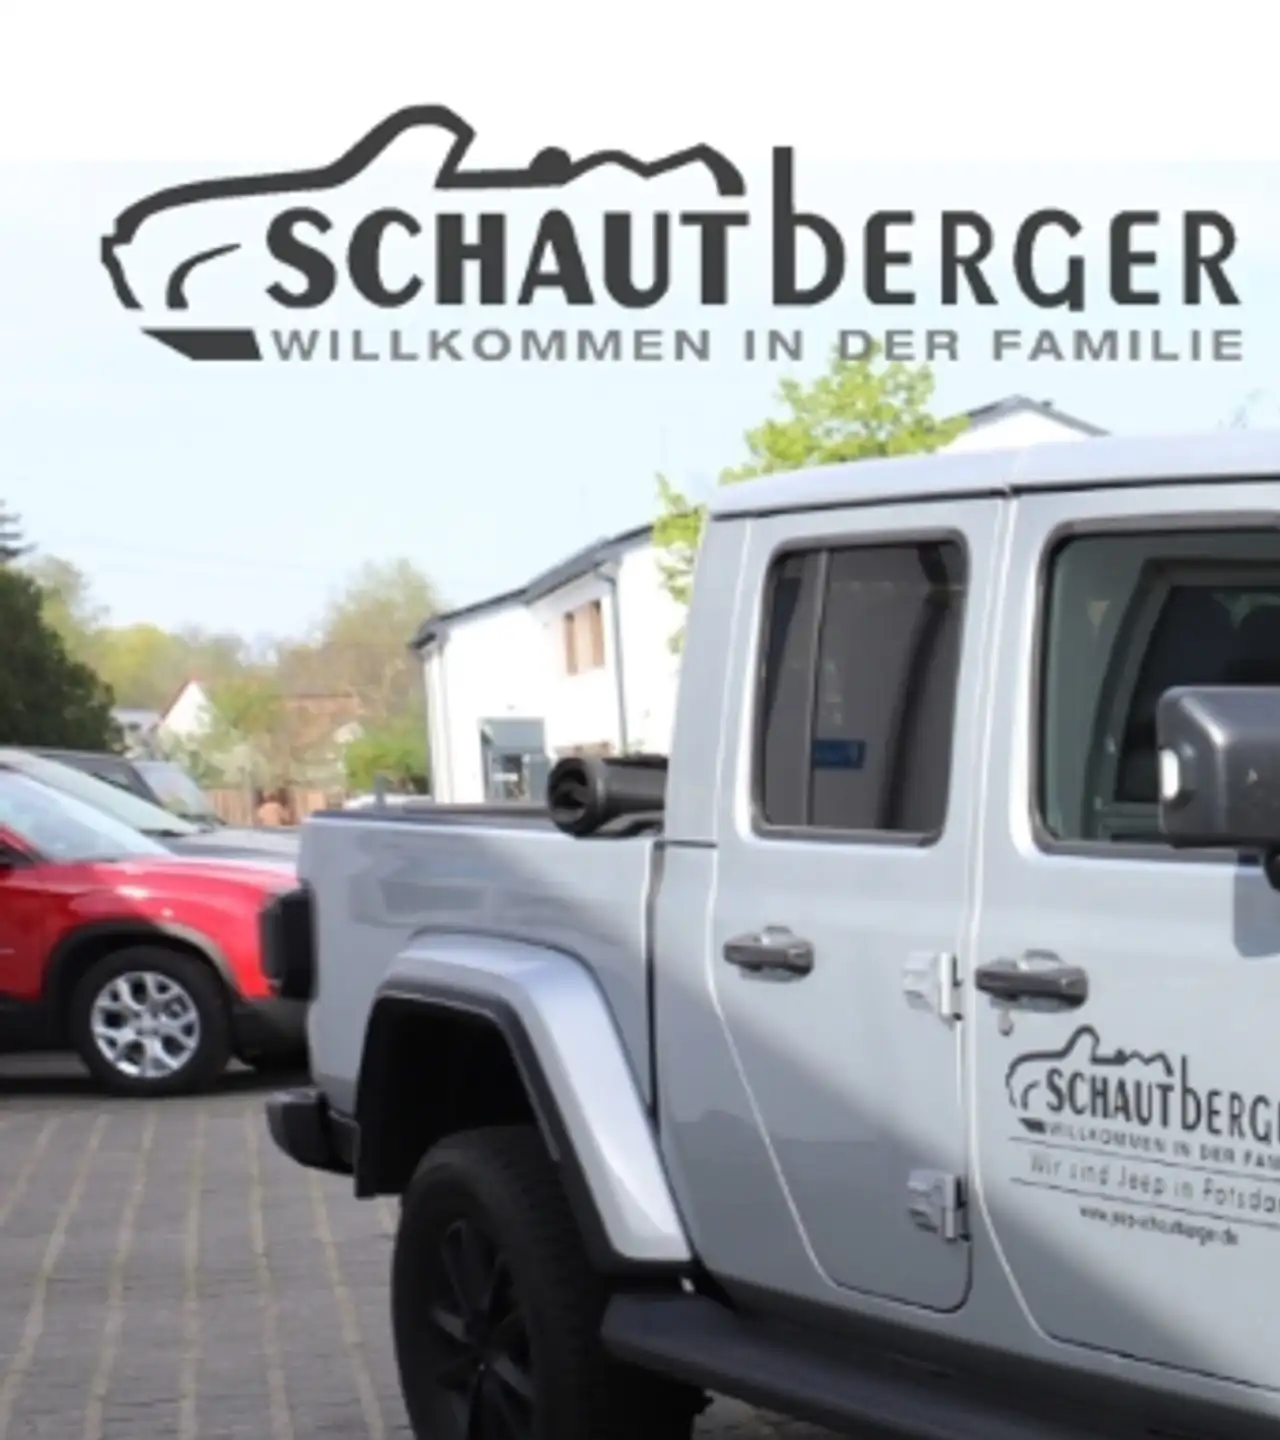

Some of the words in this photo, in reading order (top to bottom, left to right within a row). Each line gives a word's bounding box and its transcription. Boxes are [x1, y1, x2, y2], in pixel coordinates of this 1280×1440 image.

[1050, 1121, 1167, 1153] WILLKOMMEN
[1173, 1140, 1191, 1157] IN
[1199, 1143, 1236, 1164] DER
[1028, 1152, 1062, 1176] Wir
[1068, 1159, 1109, 1187] sind
[1117, 1165, 1167, 1197] Jeep
[1174, 1178, 1194, 1199] in
